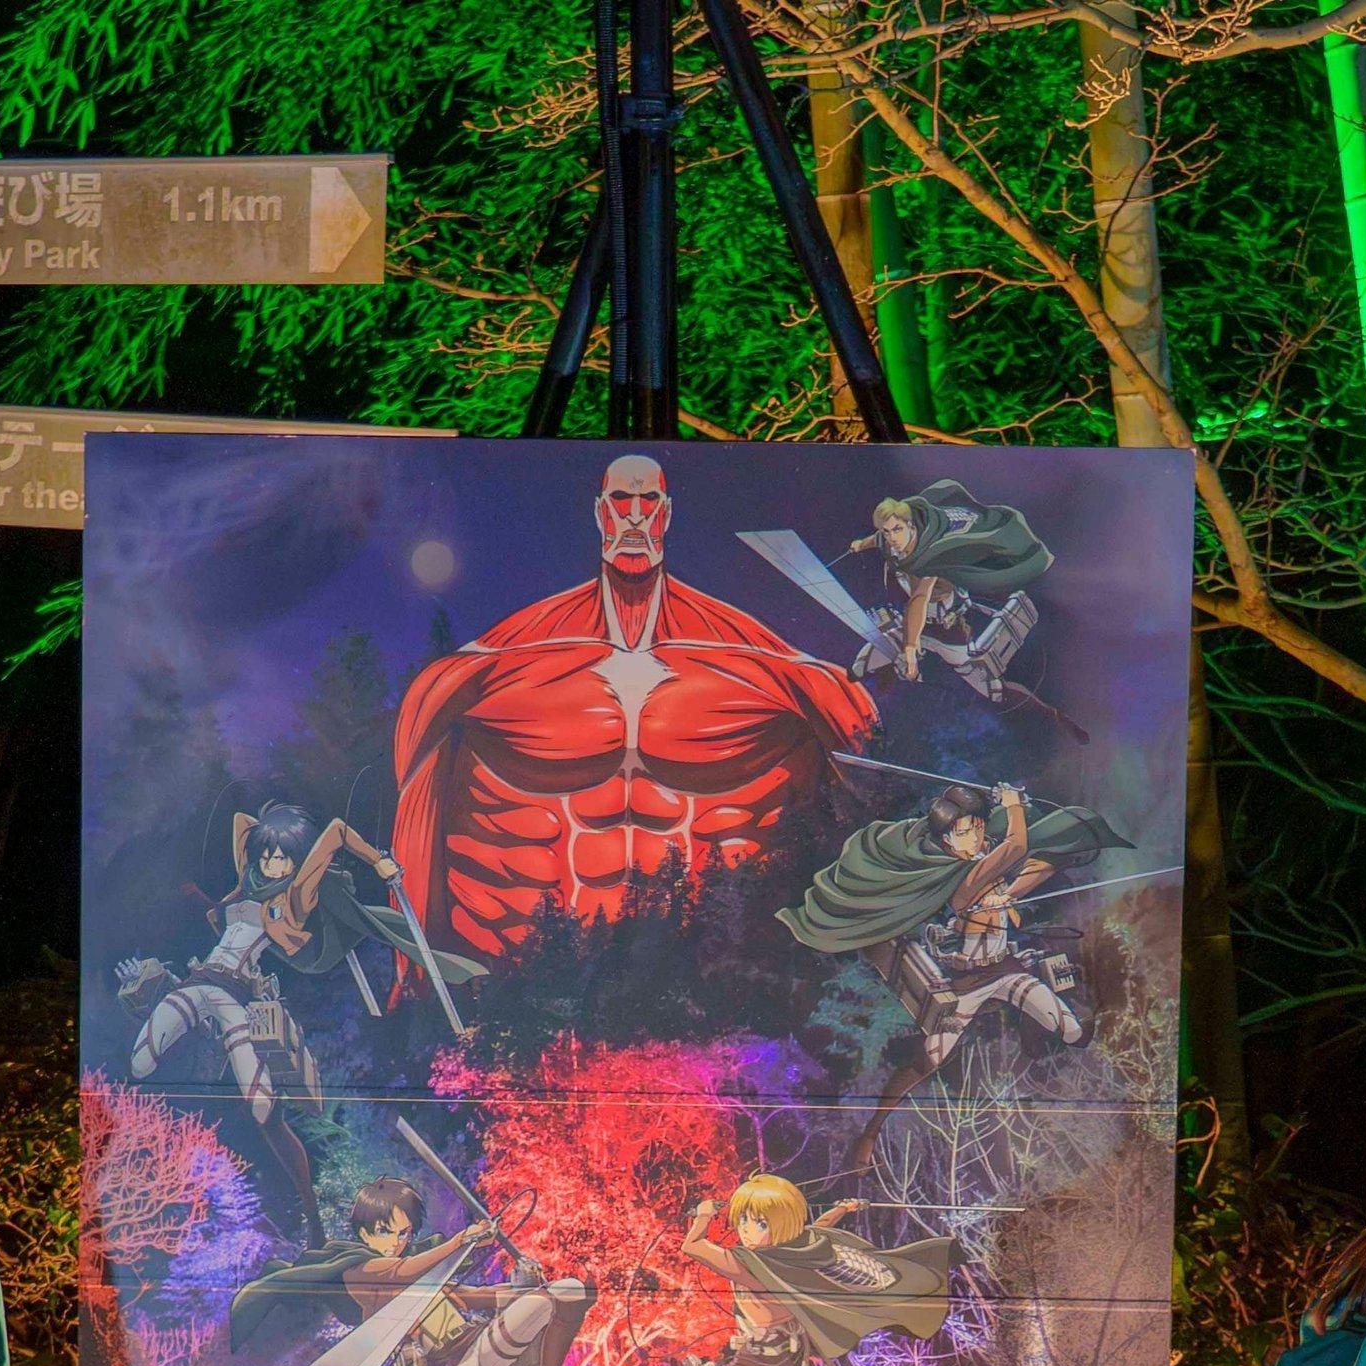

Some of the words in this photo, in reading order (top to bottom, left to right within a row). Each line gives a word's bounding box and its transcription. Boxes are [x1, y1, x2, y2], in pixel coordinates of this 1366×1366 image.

[162, 185, 283, 222] 1.1km
[23, 239, 101, 269] Park
[21, 481, 85, 511] the
